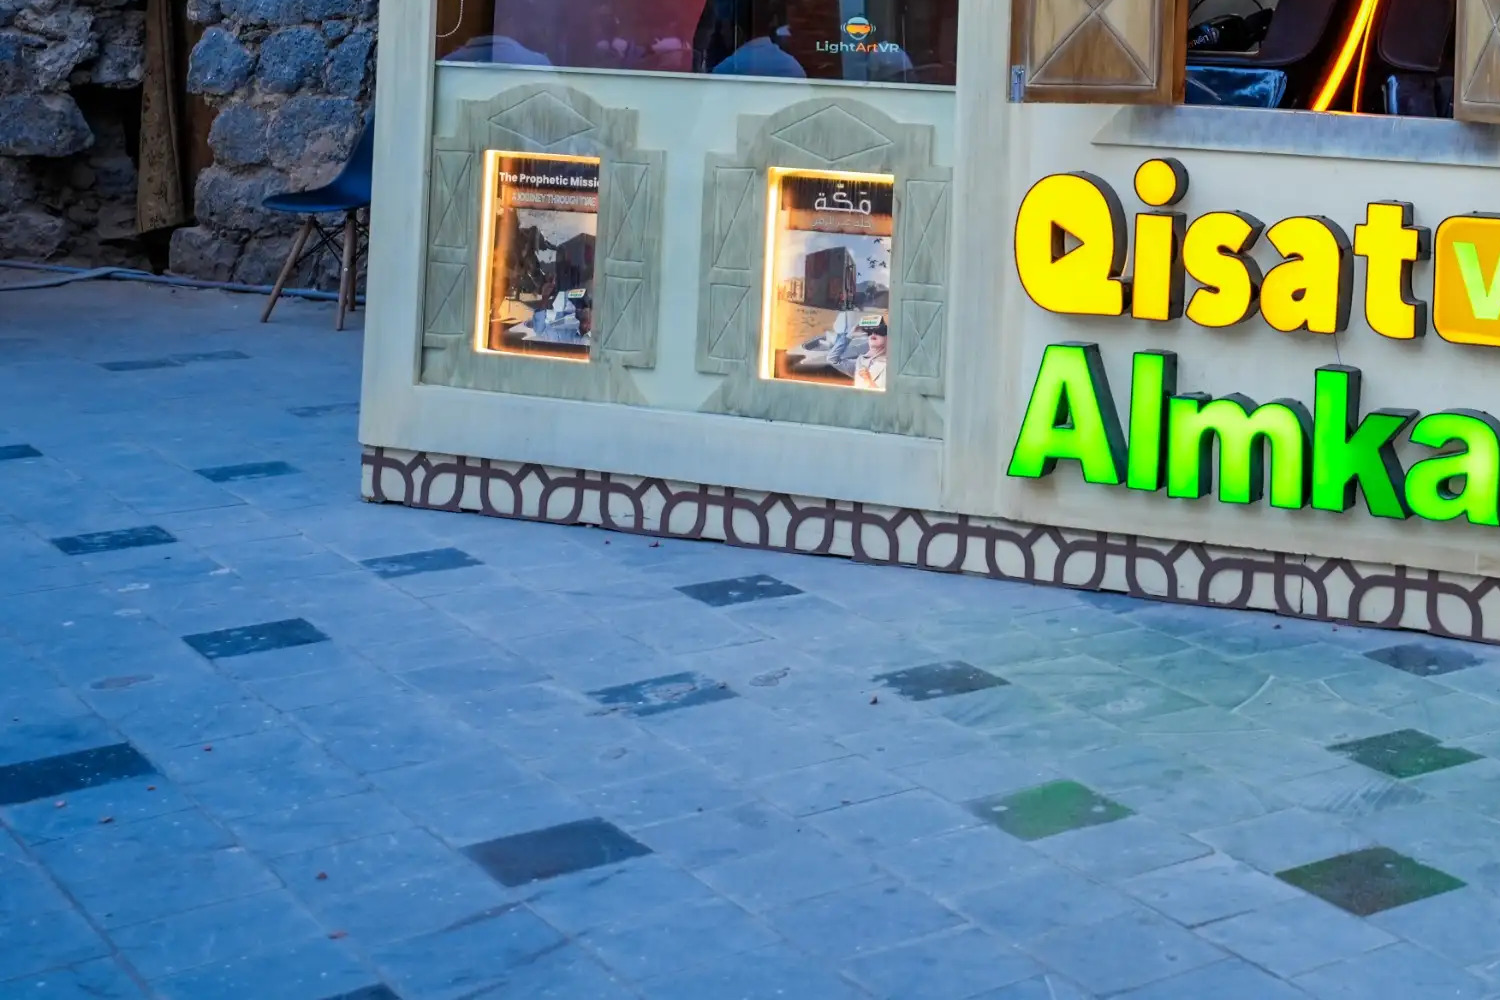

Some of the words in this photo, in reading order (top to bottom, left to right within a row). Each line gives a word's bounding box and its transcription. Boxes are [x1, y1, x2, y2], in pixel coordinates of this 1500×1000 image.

[815, 40, 900, 54] LightArtVR
[499, 171, 518, 183] The
[519, 173, 569, 188] Prophetic
[1014, 158, 1430, 340] Qisat
